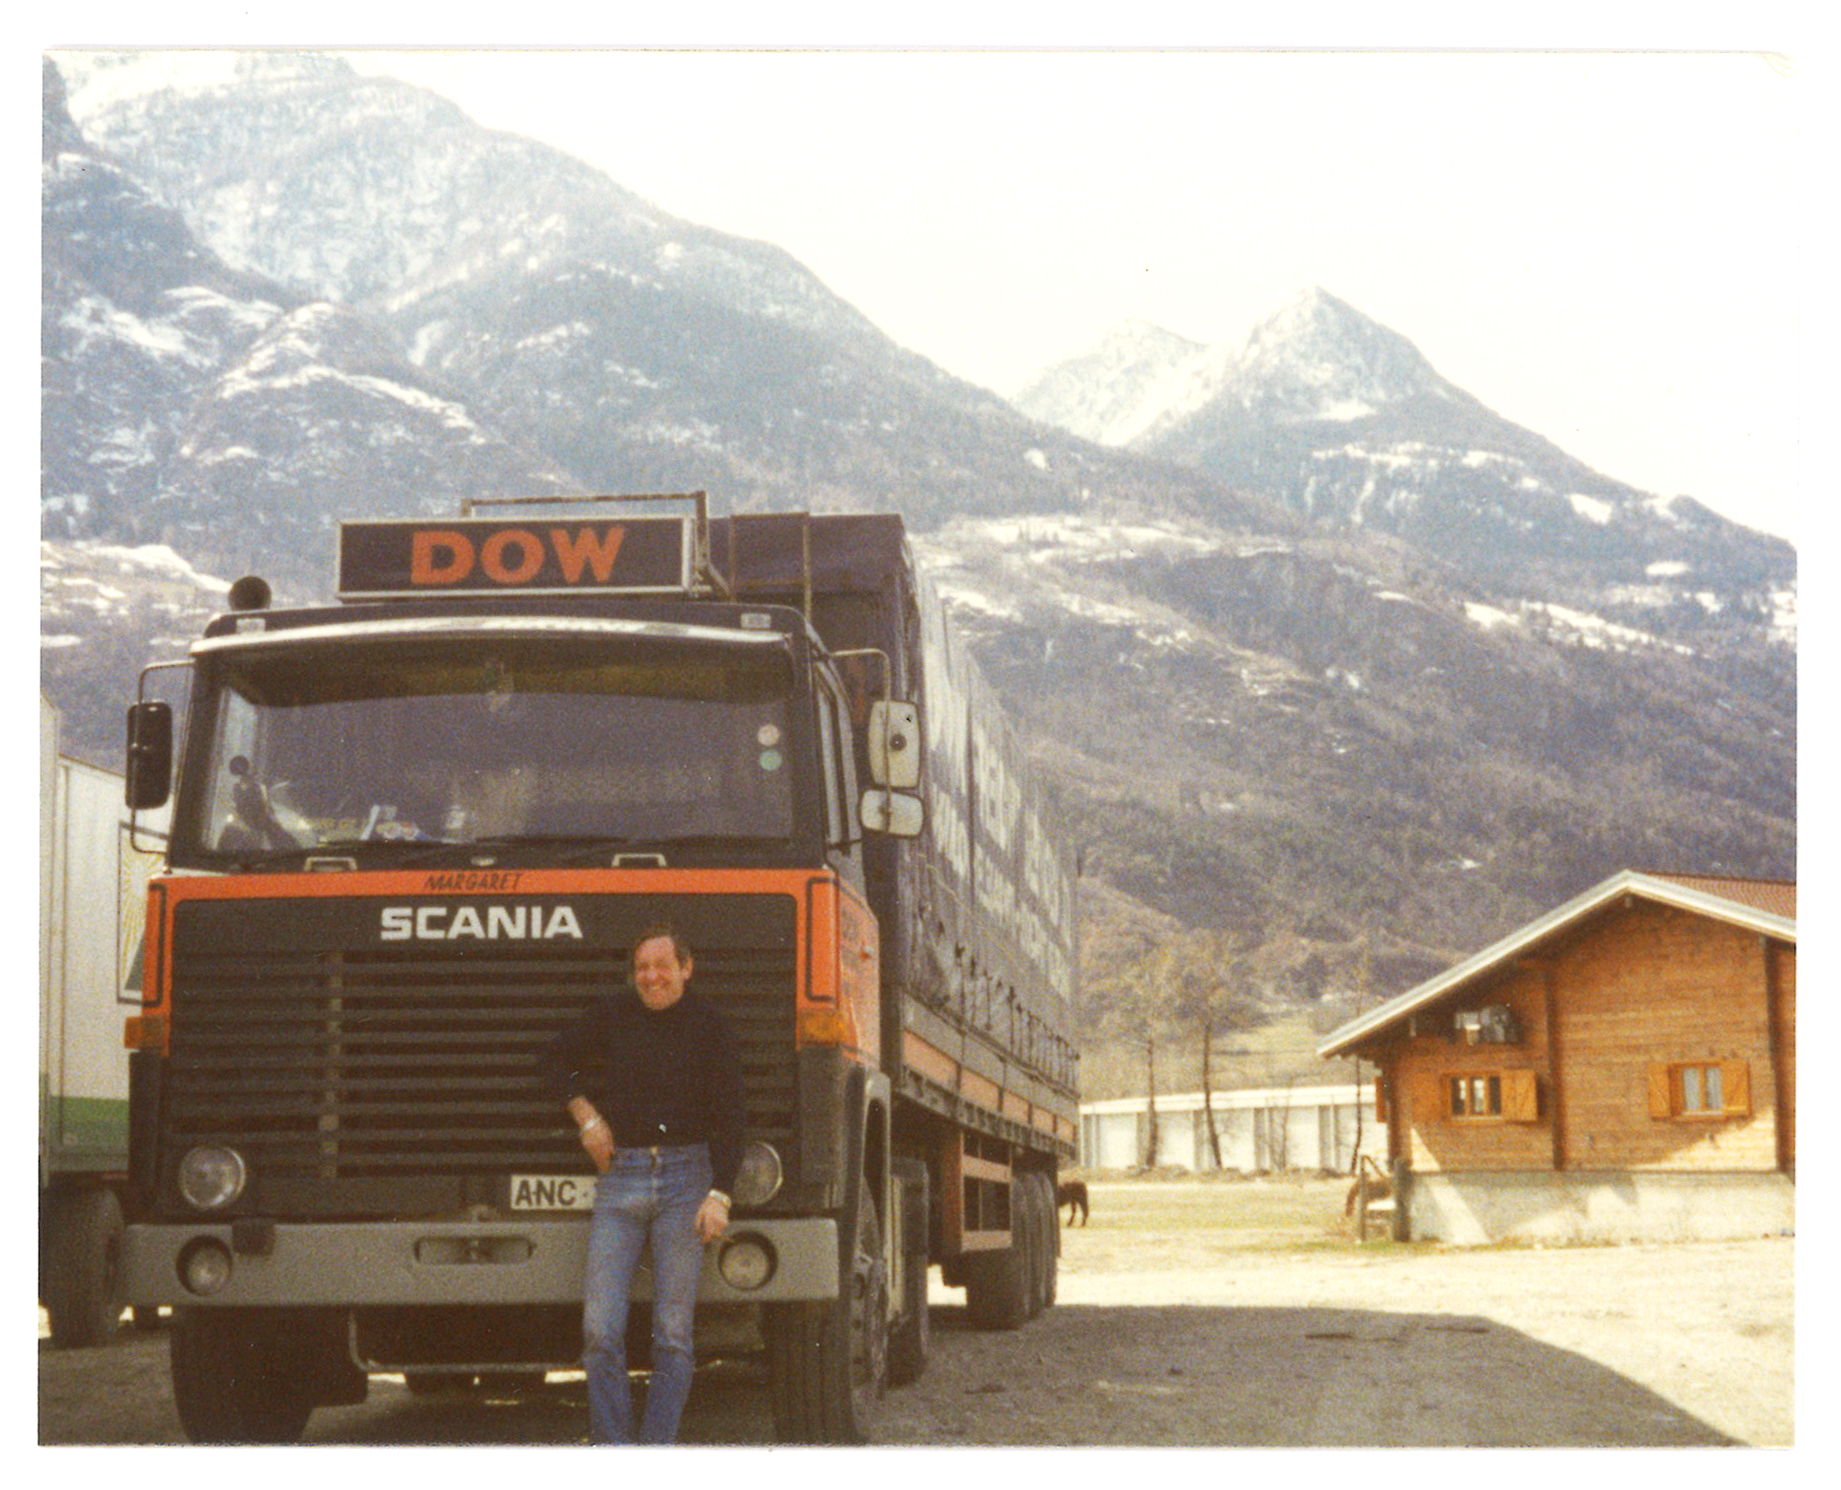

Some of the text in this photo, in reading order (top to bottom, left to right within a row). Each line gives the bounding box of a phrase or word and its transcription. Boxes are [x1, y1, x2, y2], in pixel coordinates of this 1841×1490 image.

[410, 526, 625, 584] DOW
[424, 872, 524, 891] MARGARET
[381, 905, 584, 941] SCANIA
